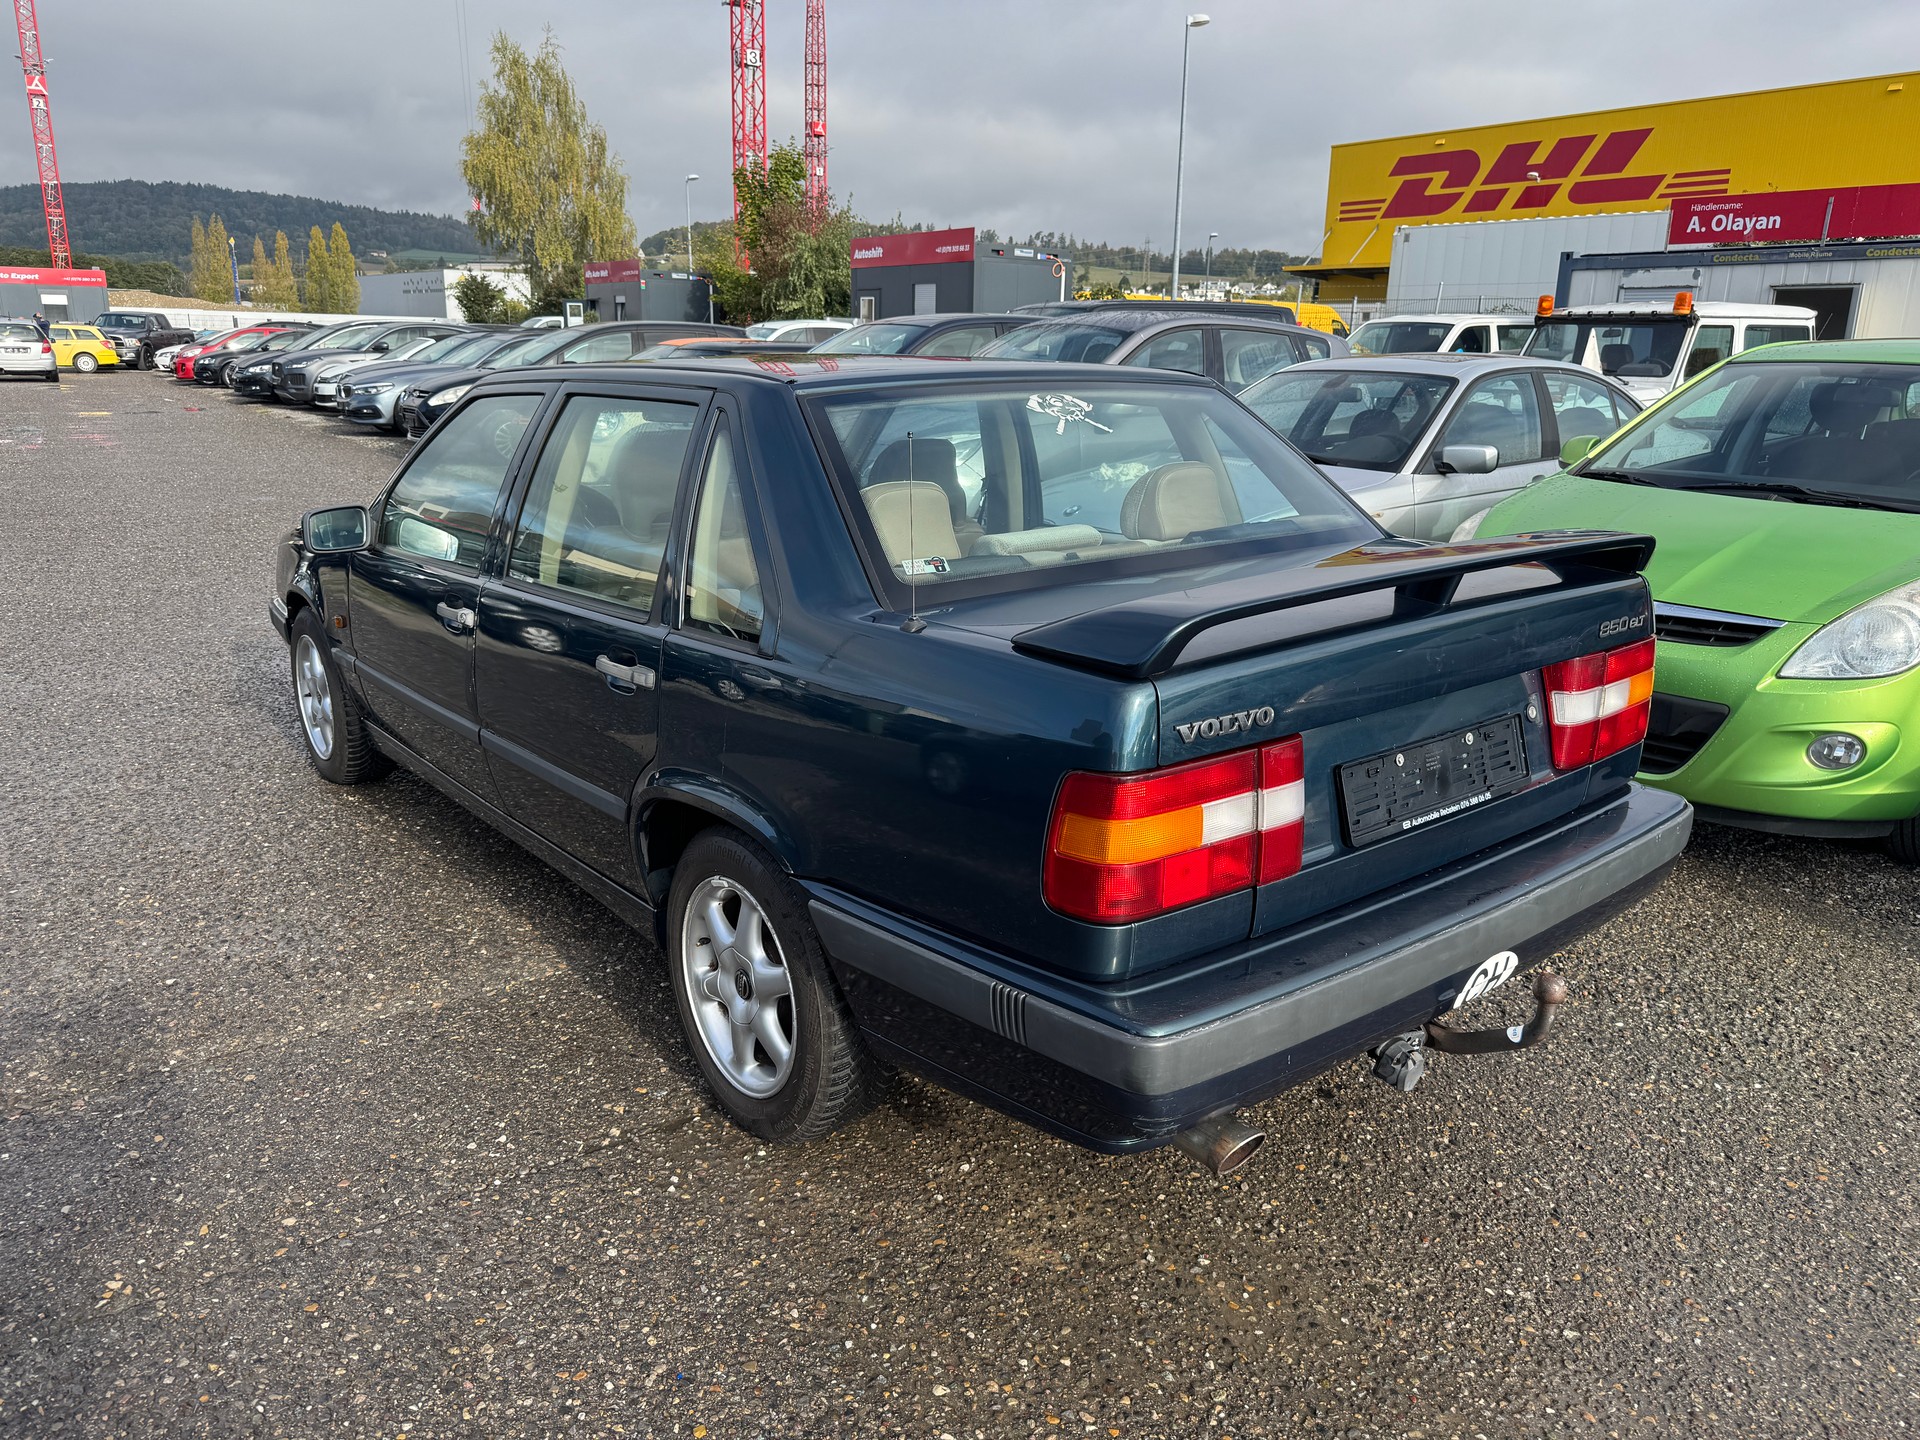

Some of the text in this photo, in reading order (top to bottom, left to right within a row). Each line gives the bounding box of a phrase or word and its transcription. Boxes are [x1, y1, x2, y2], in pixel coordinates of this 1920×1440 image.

[749, 51, 758, 64] 3
[35, 99, 42, 107] 2
[1380, 127, 1667, 219] DHL
[1691, 203, 1743, 212] Händlername:
[1686, 213, 1781, 235] A. Olayan
[854, 246, 883, 259] Autoshift
[1713, 253, 1760, 263] Condecta
[1599, 616, 1629, 638] 850
[1173, 706, 1275, 744] VOLVO
[1412, 811, 1440, 826] Automobile
[1462, 955, 1511, 1004] CH
